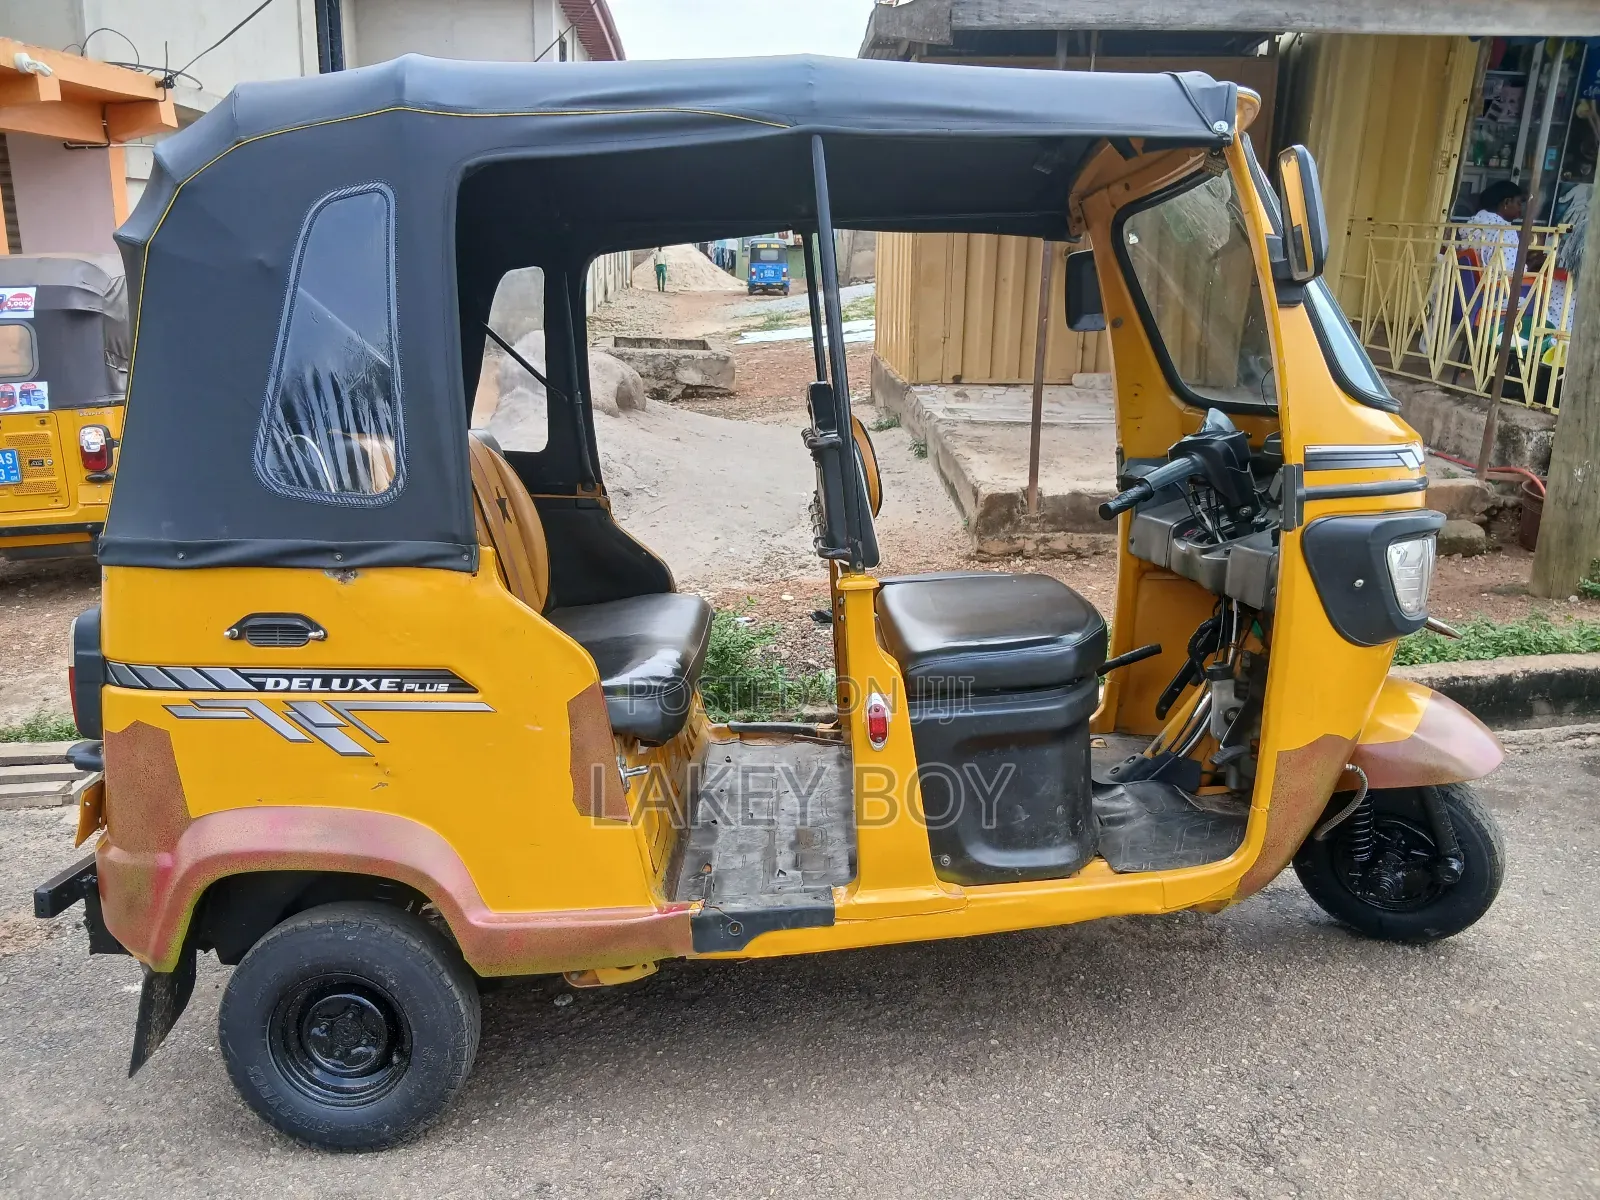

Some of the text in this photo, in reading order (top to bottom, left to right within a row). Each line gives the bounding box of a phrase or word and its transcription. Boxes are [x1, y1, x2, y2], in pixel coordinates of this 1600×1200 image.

[264, 677, 450, 693] DELUXE PLUS
[245, 1064, 294, 1118] TYRES
